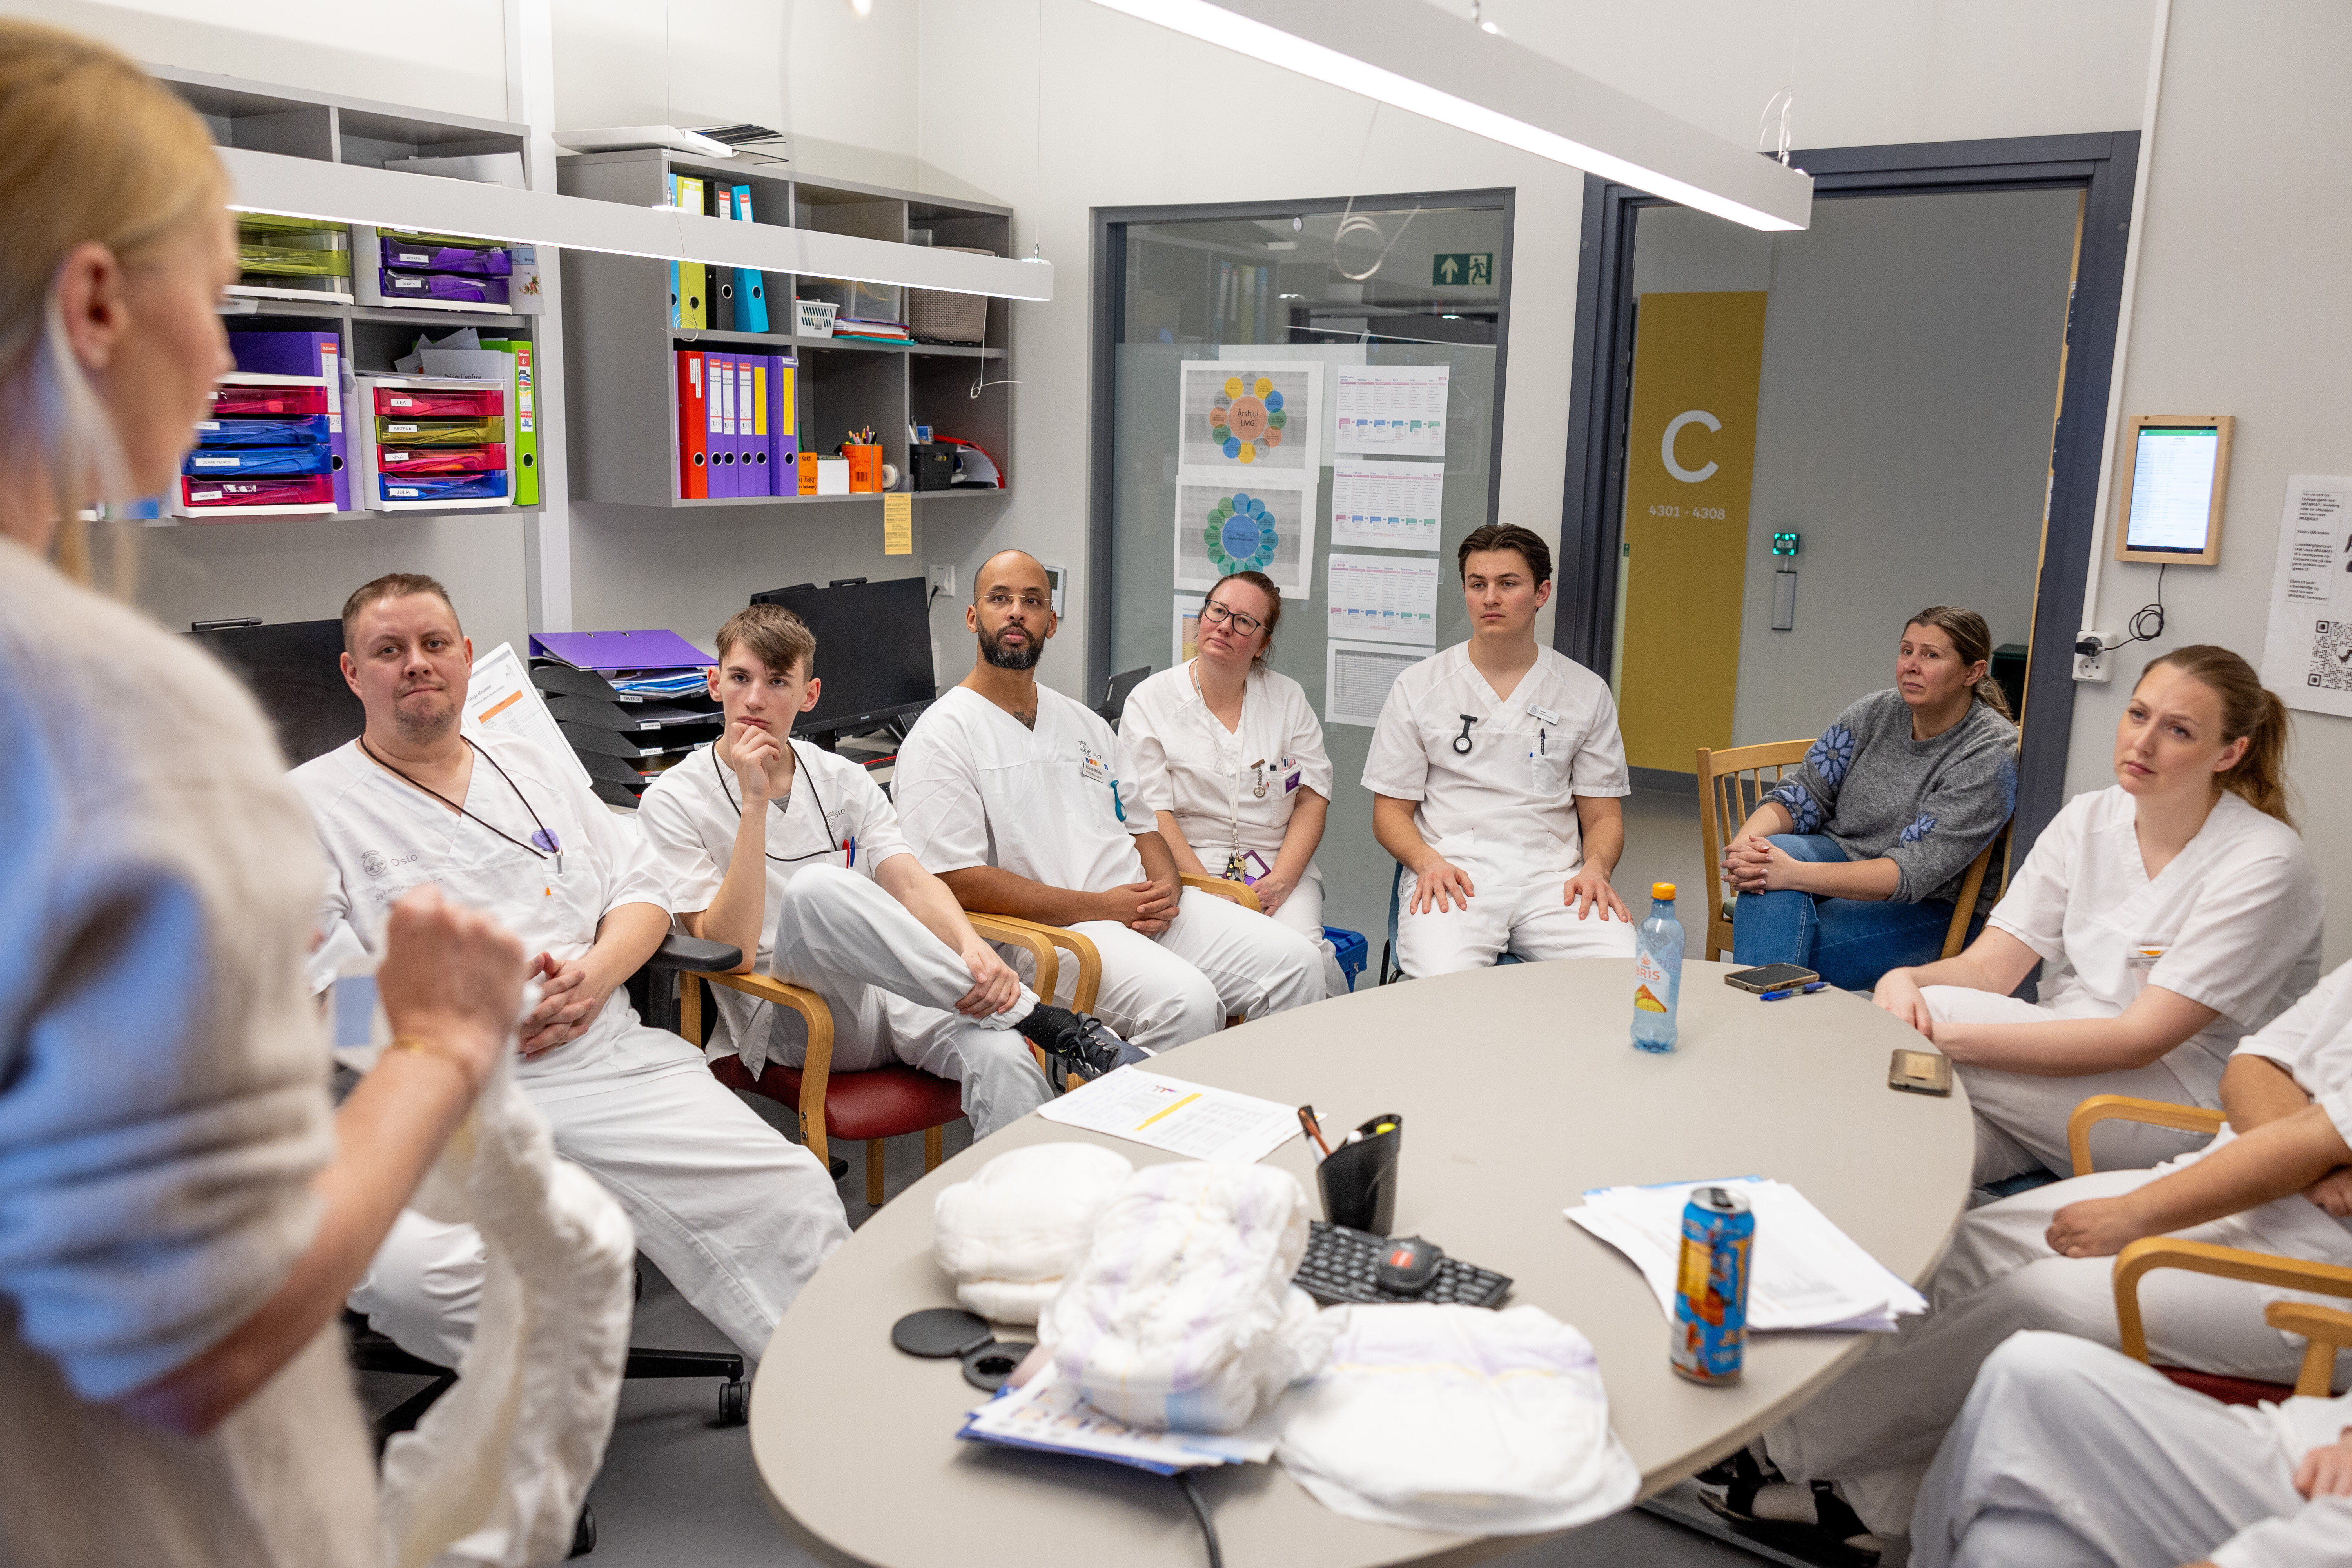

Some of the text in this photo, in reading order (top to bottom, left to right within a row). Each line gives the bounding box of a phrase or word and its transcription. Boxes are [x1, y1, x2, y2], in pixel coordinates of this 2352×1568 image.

[1237, 408, 1259, 418] Årshjul
[1661, 409, 1723, 483] C
[1649, 505, 1681, 518] 4301
[1692, 507, 1725, 520] 4308
[467, 693, 478, 702] Viktige
[835, 808, 845, 818] slo
[391, 854, 417, 866] Oslo
[1635, 965, 1660, 980] BRIS
